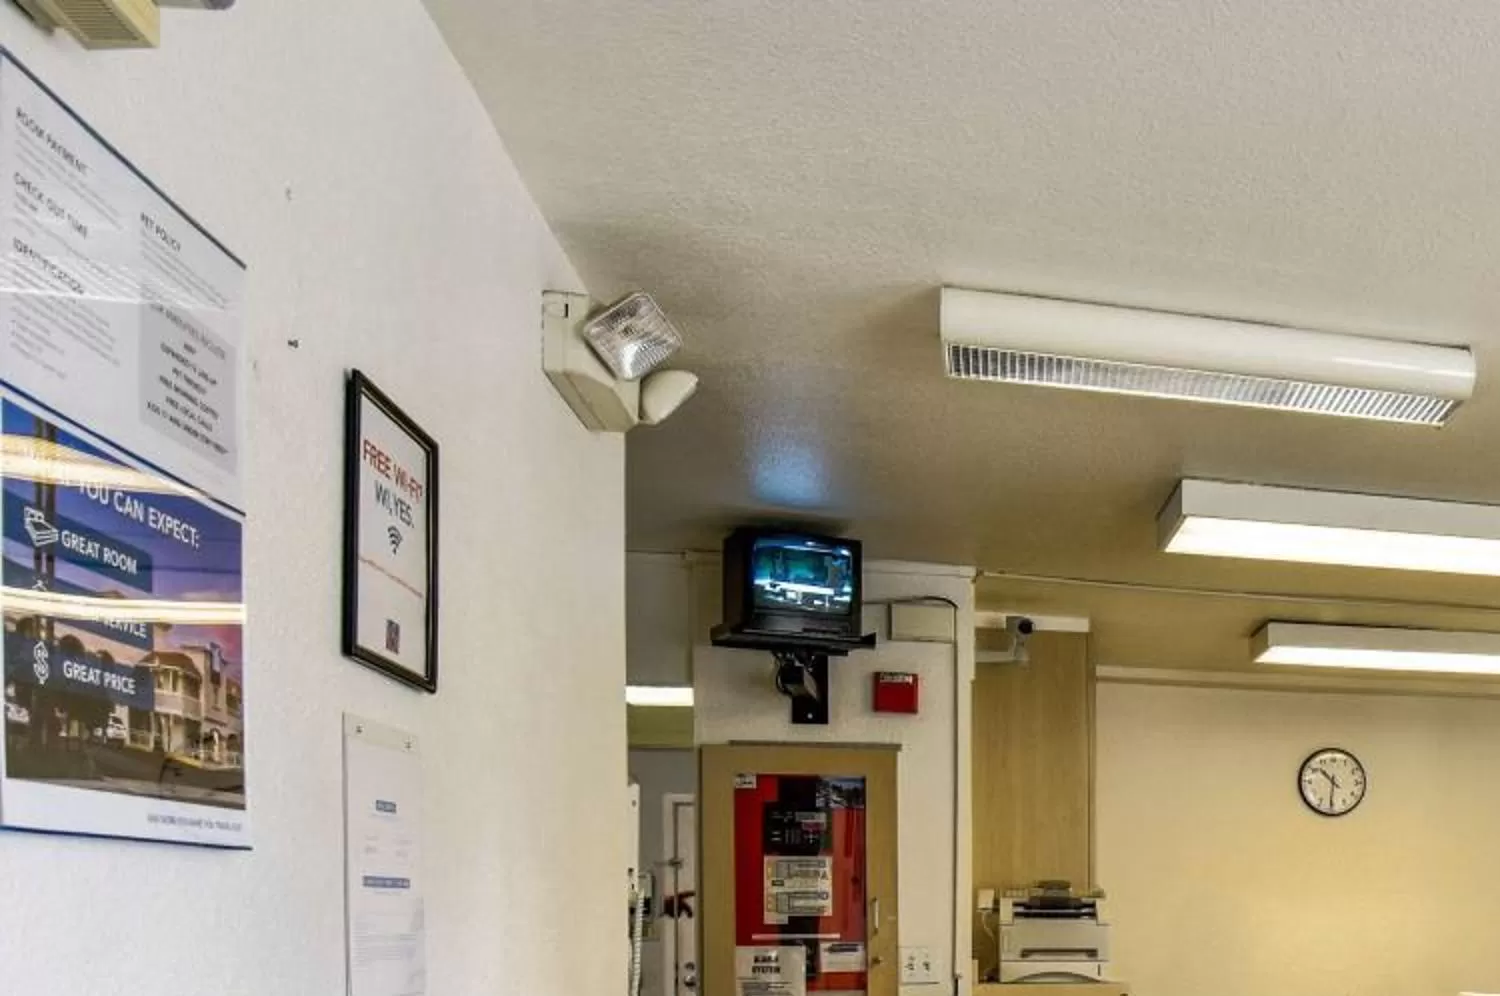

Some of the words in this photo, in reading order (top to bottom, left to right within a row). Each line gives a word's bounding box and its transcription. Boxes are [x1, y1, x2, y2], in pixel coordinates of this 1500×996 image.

[363, 439, 391, 480] FREE
[114, 491, 144, 523] CAN
[61, 530, 101, 559] GREAT
[103, 547, 138, 574] ROOM
[62, 660, 101, 686] GREAT
[103, 671, 136, 695] PRICE
